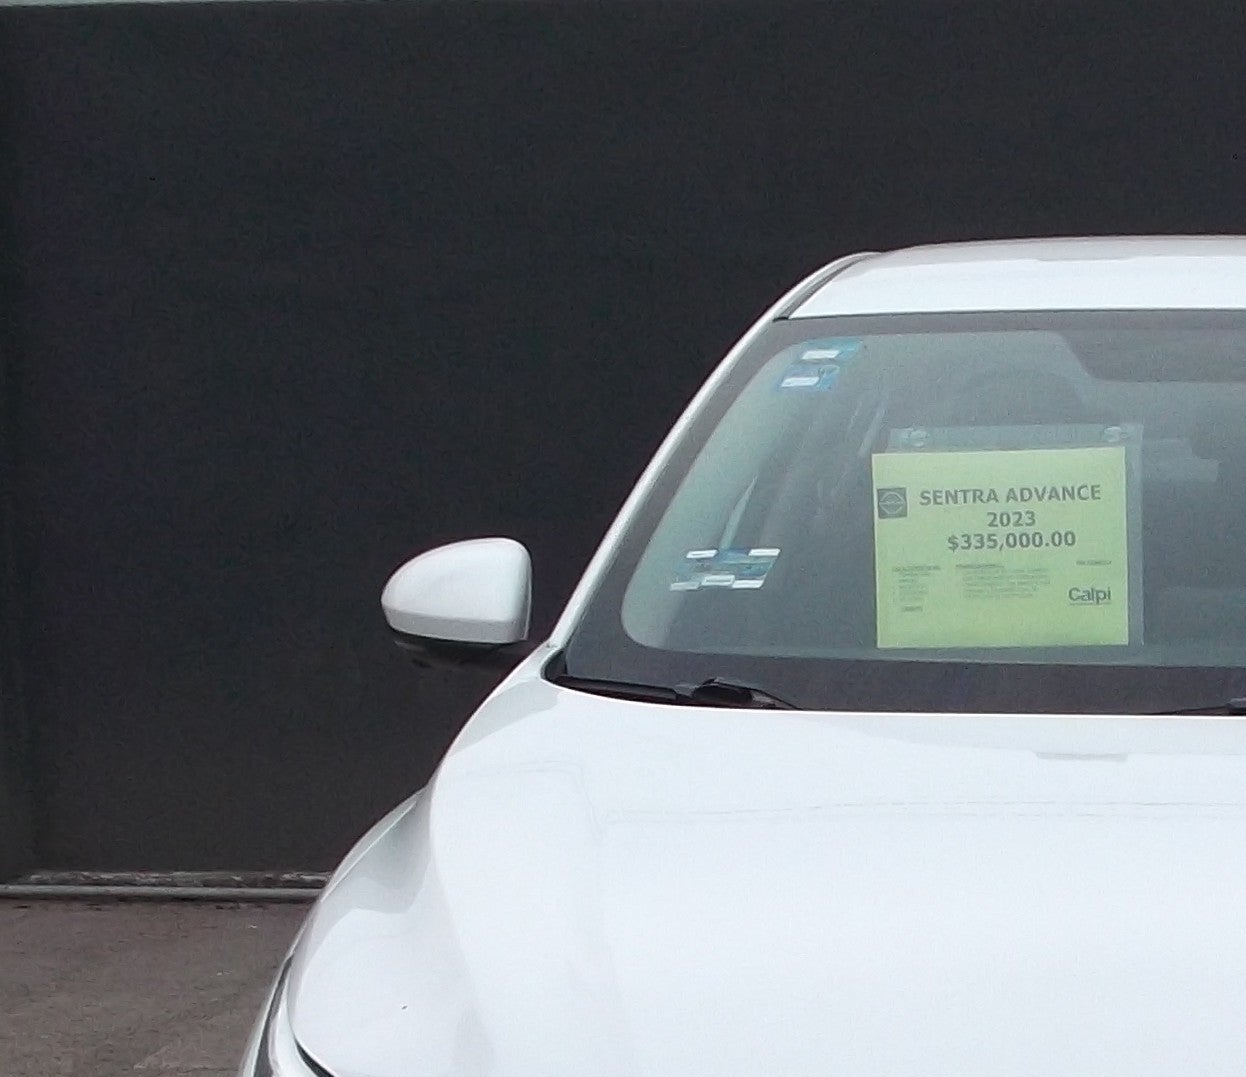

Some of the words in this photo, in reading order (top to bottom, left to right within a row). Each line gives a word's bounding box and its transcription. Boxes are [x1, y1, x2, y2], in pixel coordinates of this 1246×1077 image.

[919, 488, 999, 505] SENTRA
[1005, 485, 1101, 503] ADVANCE
[987, 511, 1036, 528] 2023
[948, 531, 1076, 553] $335,000.00
[1068, 586, 1111, 605] Calpi
